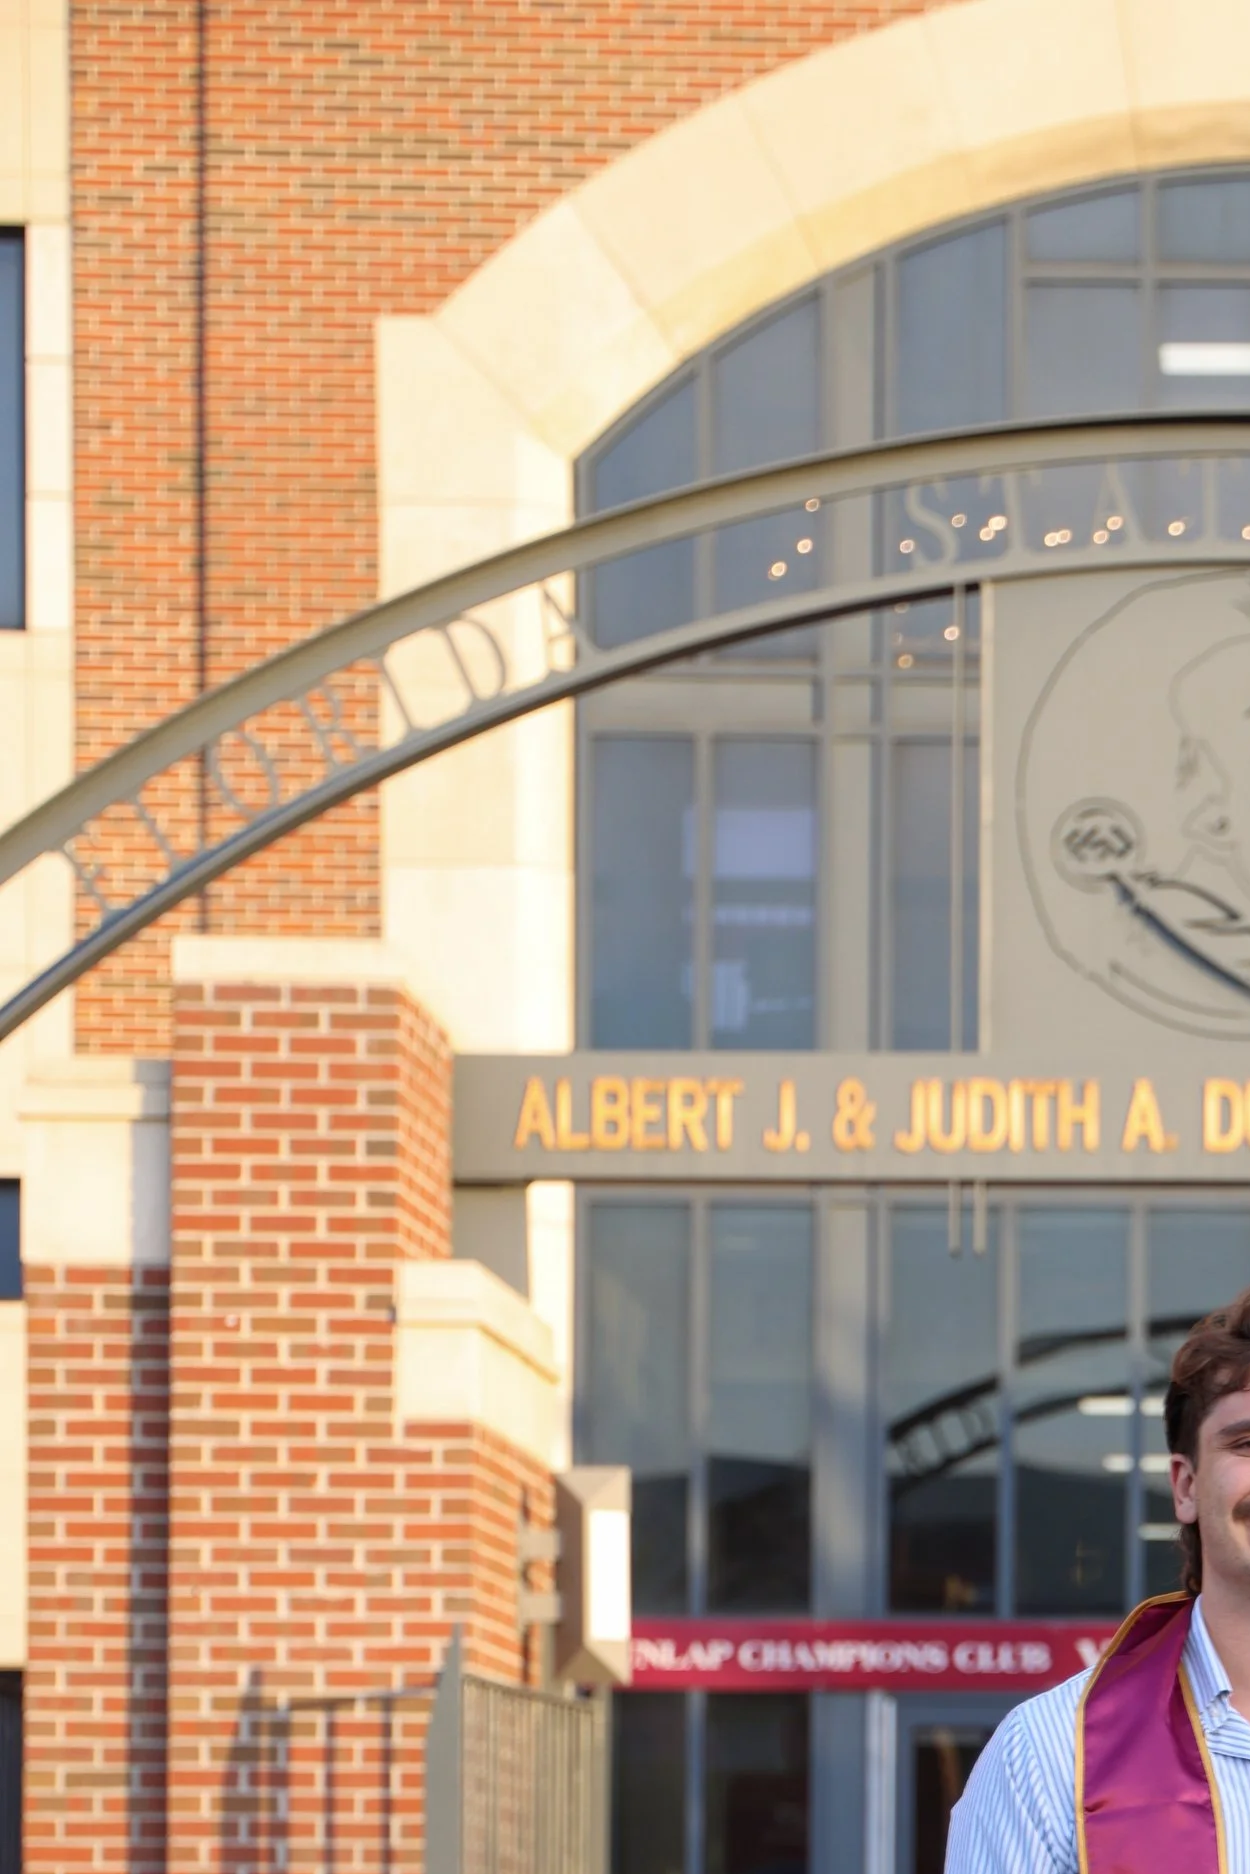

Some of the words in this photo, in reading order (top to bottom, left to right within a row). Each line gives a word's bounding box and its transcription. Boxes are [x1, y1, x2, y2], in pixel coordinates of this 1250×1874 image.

[514, 1076, 744, 1152] ALBERT
[763, 1078, 810, 1152] J.
[832, 1078, 876, 1152] &
[895, 1078, 1100, 1153] JUDITH
[1122, 1078, 1178, 1153] A.
[634, 1637, 736, 1672] NLAP
[738, 1638, 948, 1675] CHAMPIONS
[953, 1640, 1052, 1674] CLUB
